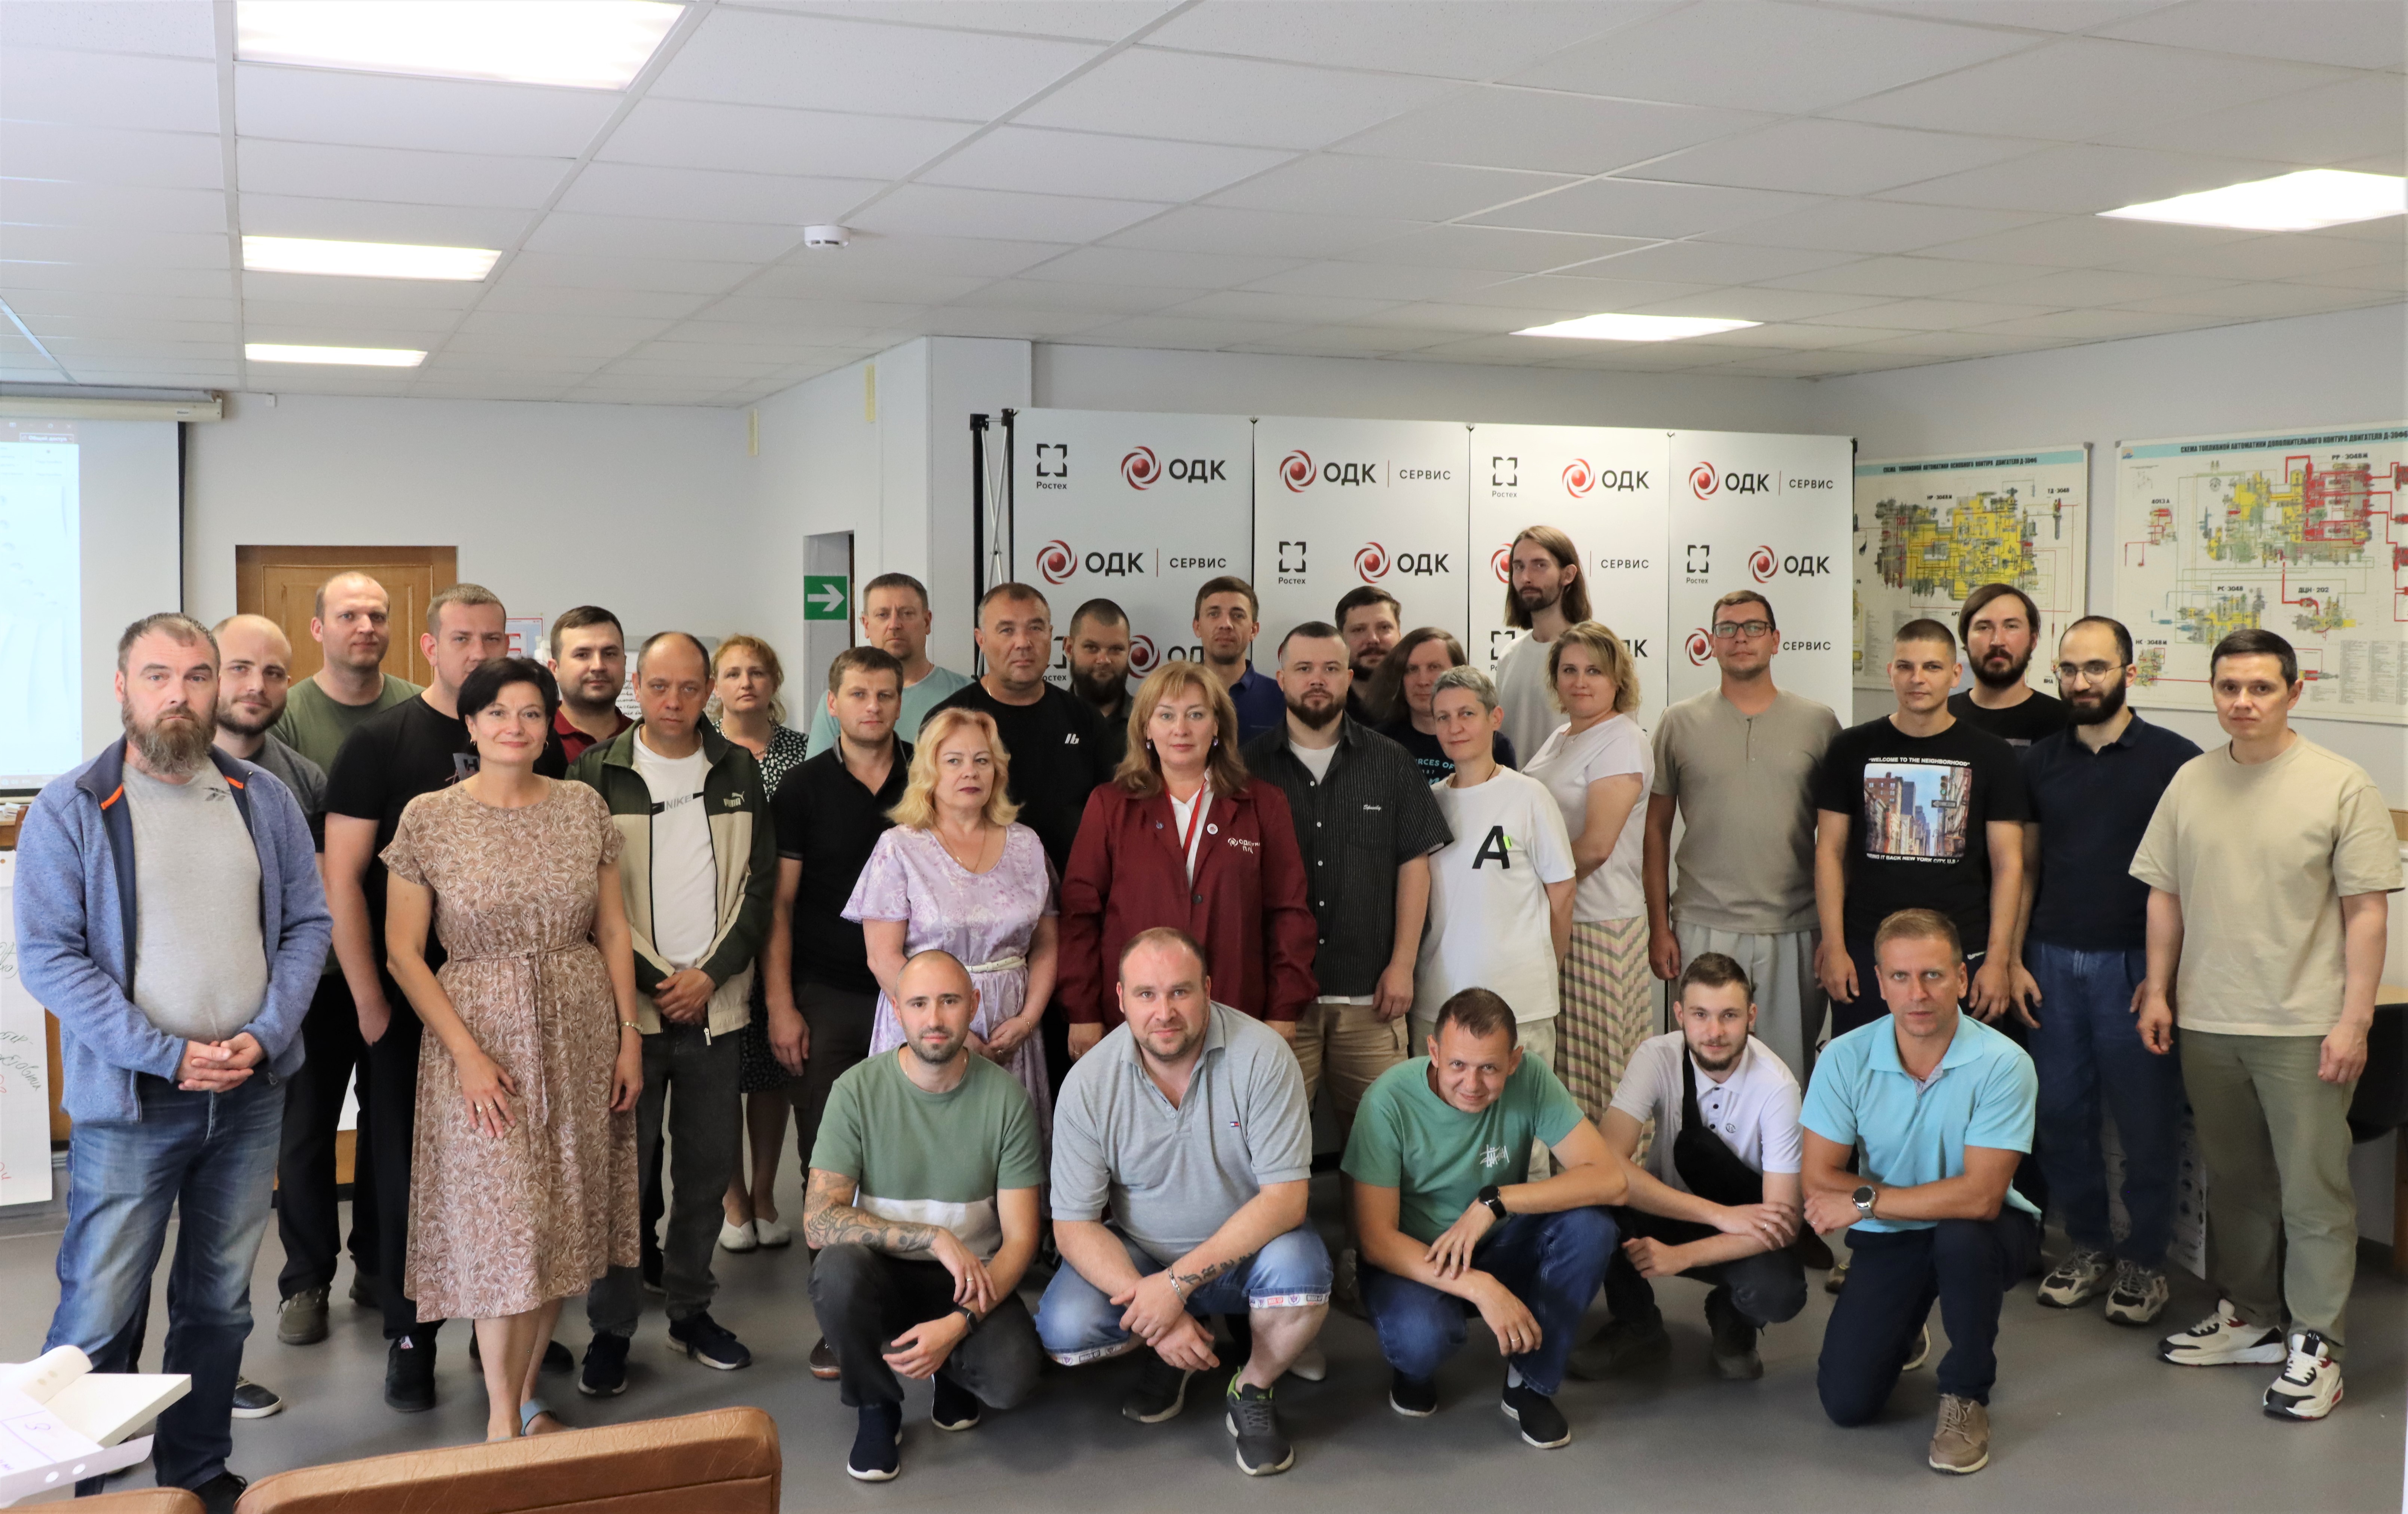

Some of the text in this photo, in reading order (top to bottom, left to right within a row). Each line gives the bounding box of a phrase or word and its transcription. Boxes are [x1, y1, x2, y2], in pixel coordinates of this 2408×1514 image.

[2323, 435, 2348, 443] КОНТУРА
[2349, 432, 2383, 442] ДВИГАТЕЛЯ
[1169, 459, 1226, 483] ОДК
[1995, 458, 2019, 467] ДВИГАТЕЛЯ
[1323, 462, 1450, 486] ОДК СЕРВИС
[1602, 470, 1649, 492] ОДК
[1725, 473, 1833, 494] ОДК СЕРВИС
[1085, 552, 1226, 576] ОДК СЕРВИС
[1397, 553, 1449, 576] ОДК
[1601, 559, 1649, 568] СЕРВИС
[1784, 556, 1830, 576] ОДК
[1168, 646, 1204, 664] ОД
[1783, 642, 1831, 651] СЕРВИС
[1416, 758, 1440, 767] RCES
[666, 794, 692, 810] NIKE
